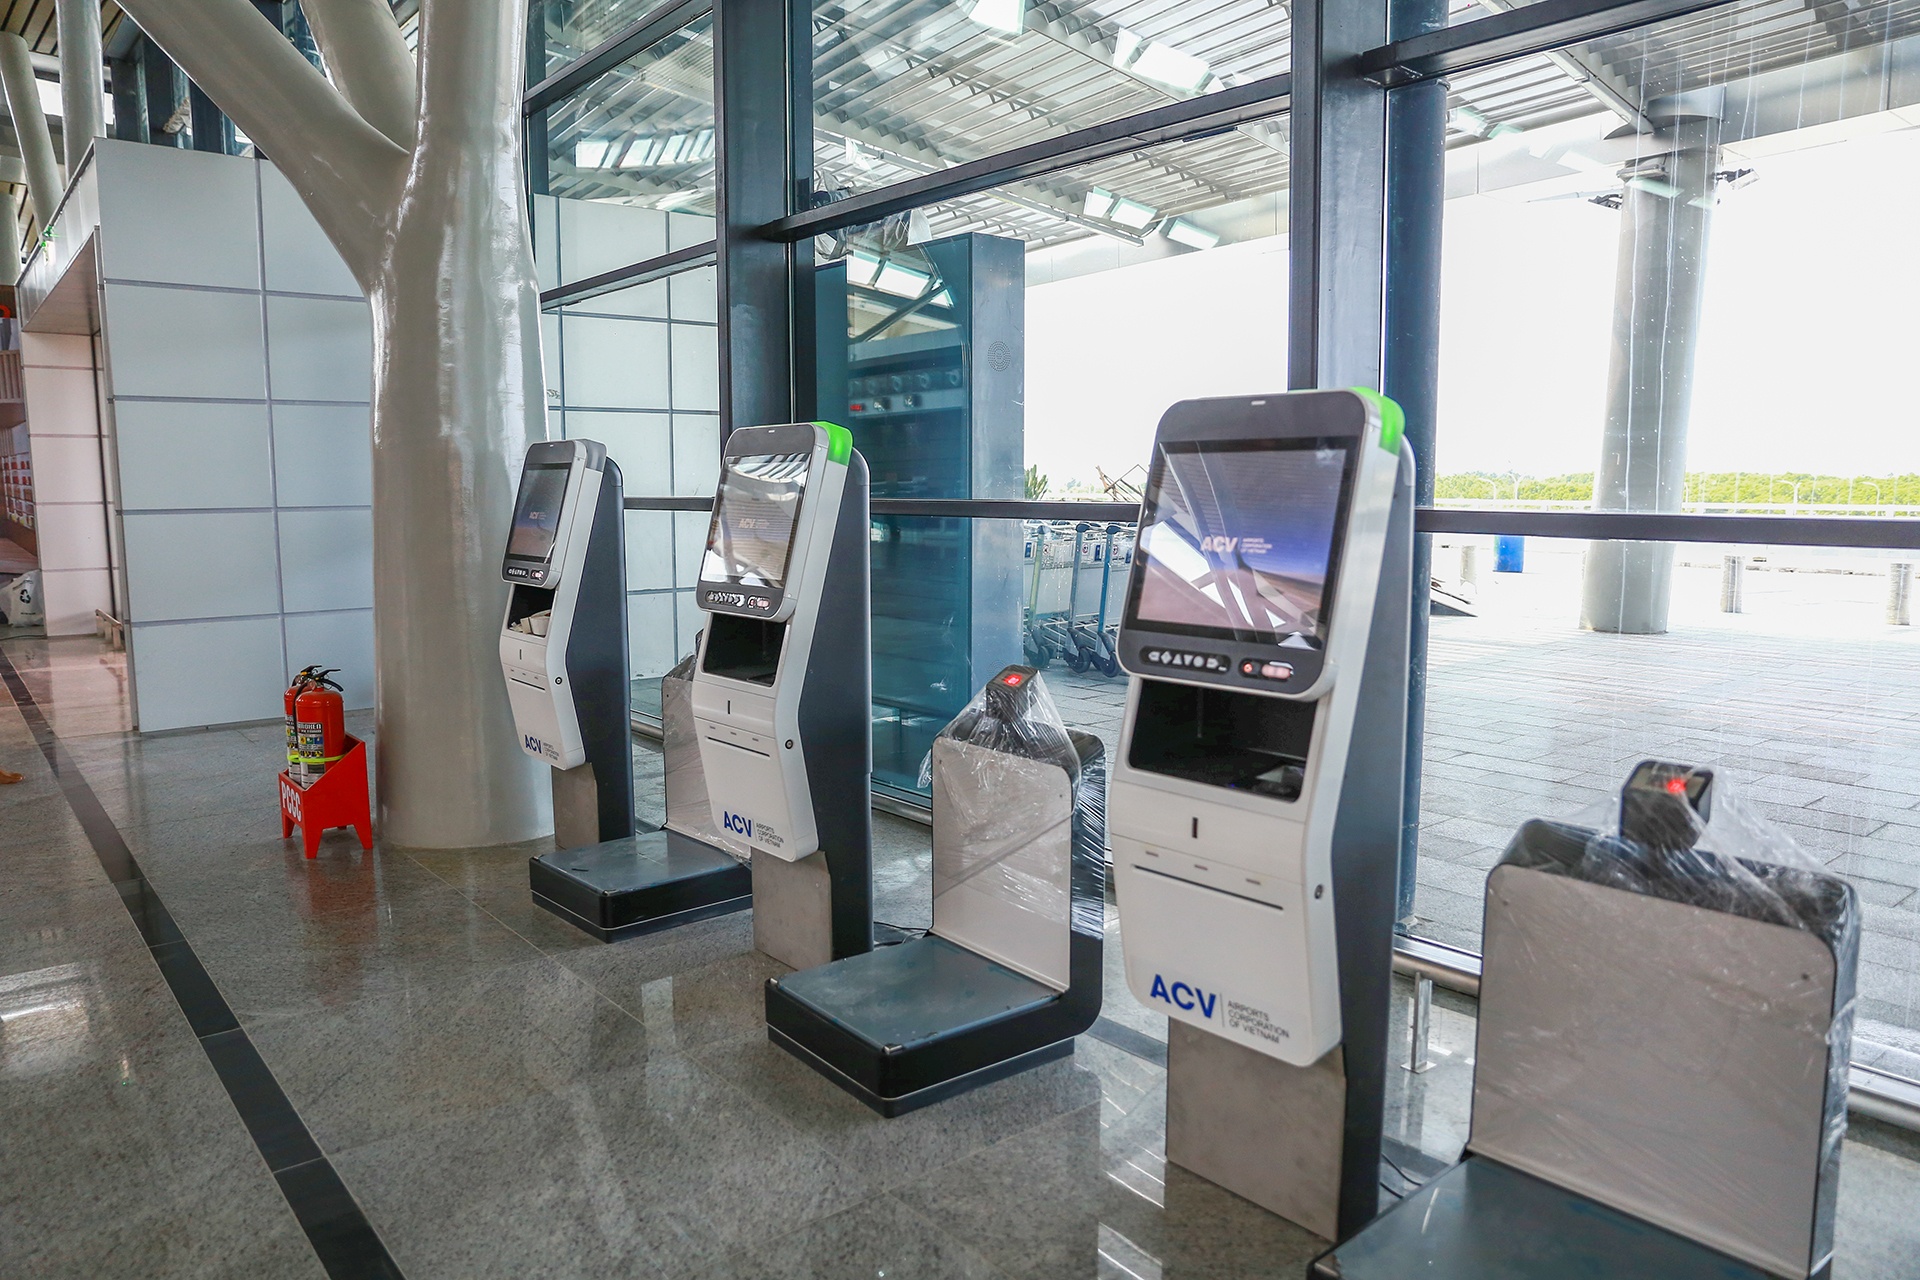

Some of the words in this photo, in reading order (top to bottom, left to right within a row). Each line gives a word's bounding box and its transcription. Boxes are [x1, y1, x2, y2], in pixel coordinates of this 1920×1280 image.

[1200, 536, 1238, 553] ACV
[525, 734, 542, 754] ACV
[281, 781, 302, 822] PCCC
[724, 810, 752, 838] ACV
[1150, 973, 1216, 1019] ACV
[1228, 1000, 1269, 1021] AIRPORTS
[1228, 1009, 1289, 1038] CORPORATION
[1229, 1018, 1240, 1028] OF
[1244, 1025, 1280, 1044] VIETNAM
